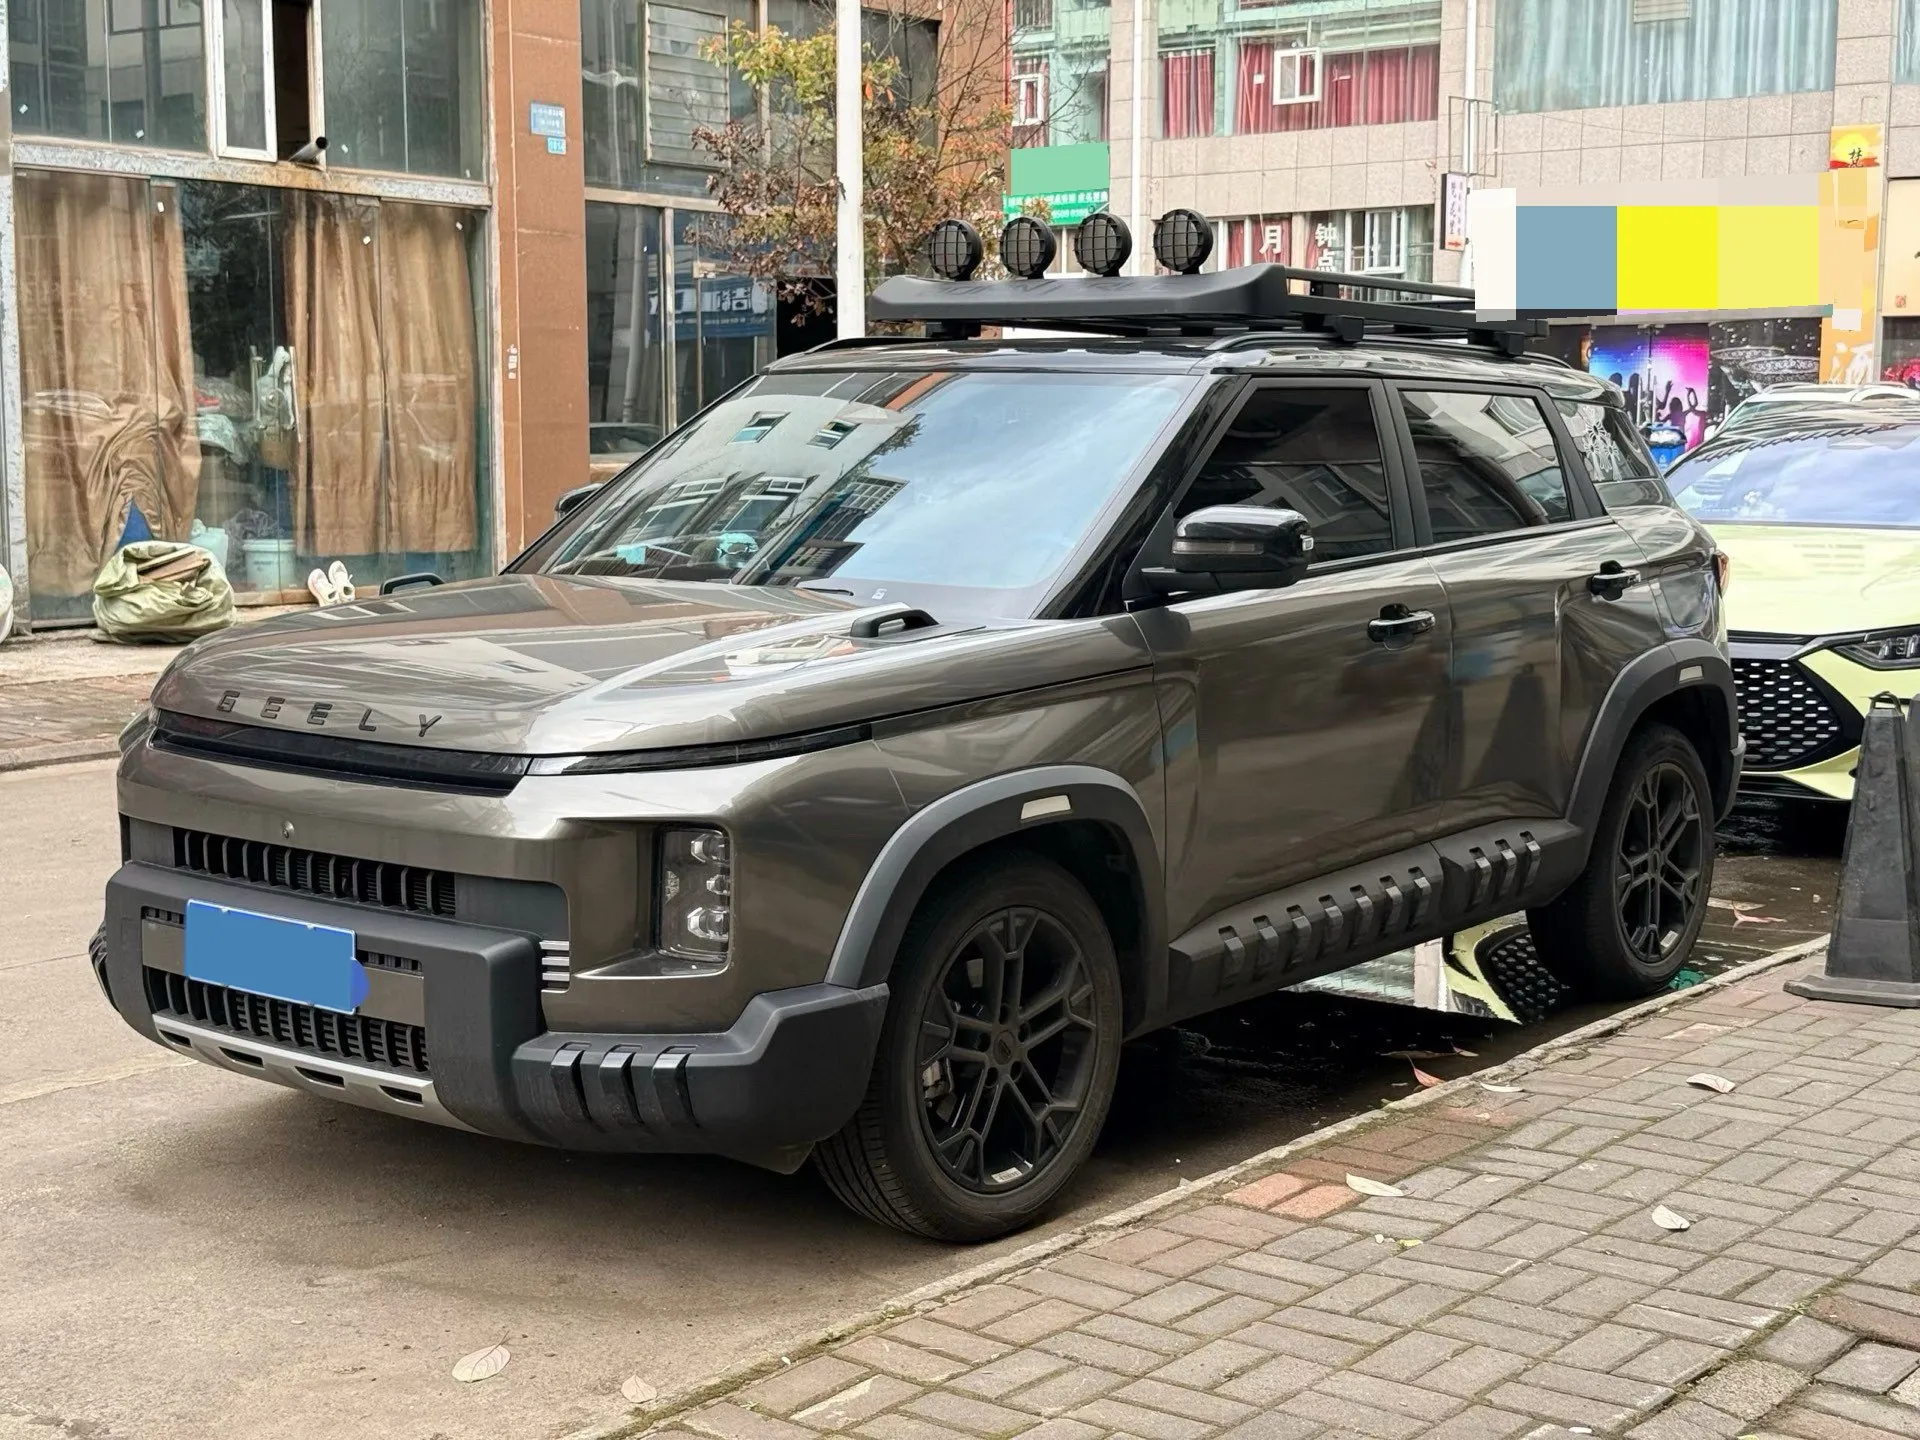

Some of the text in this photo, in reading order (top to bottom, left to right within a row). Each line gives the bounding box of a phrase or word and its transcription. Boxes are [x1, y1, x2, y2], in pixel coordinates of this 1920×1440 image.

[1259, 224, 1282, 254] 月
[1314, 222, 1338, 272] 钟点
[216, 690, 442, 737] GEELY
